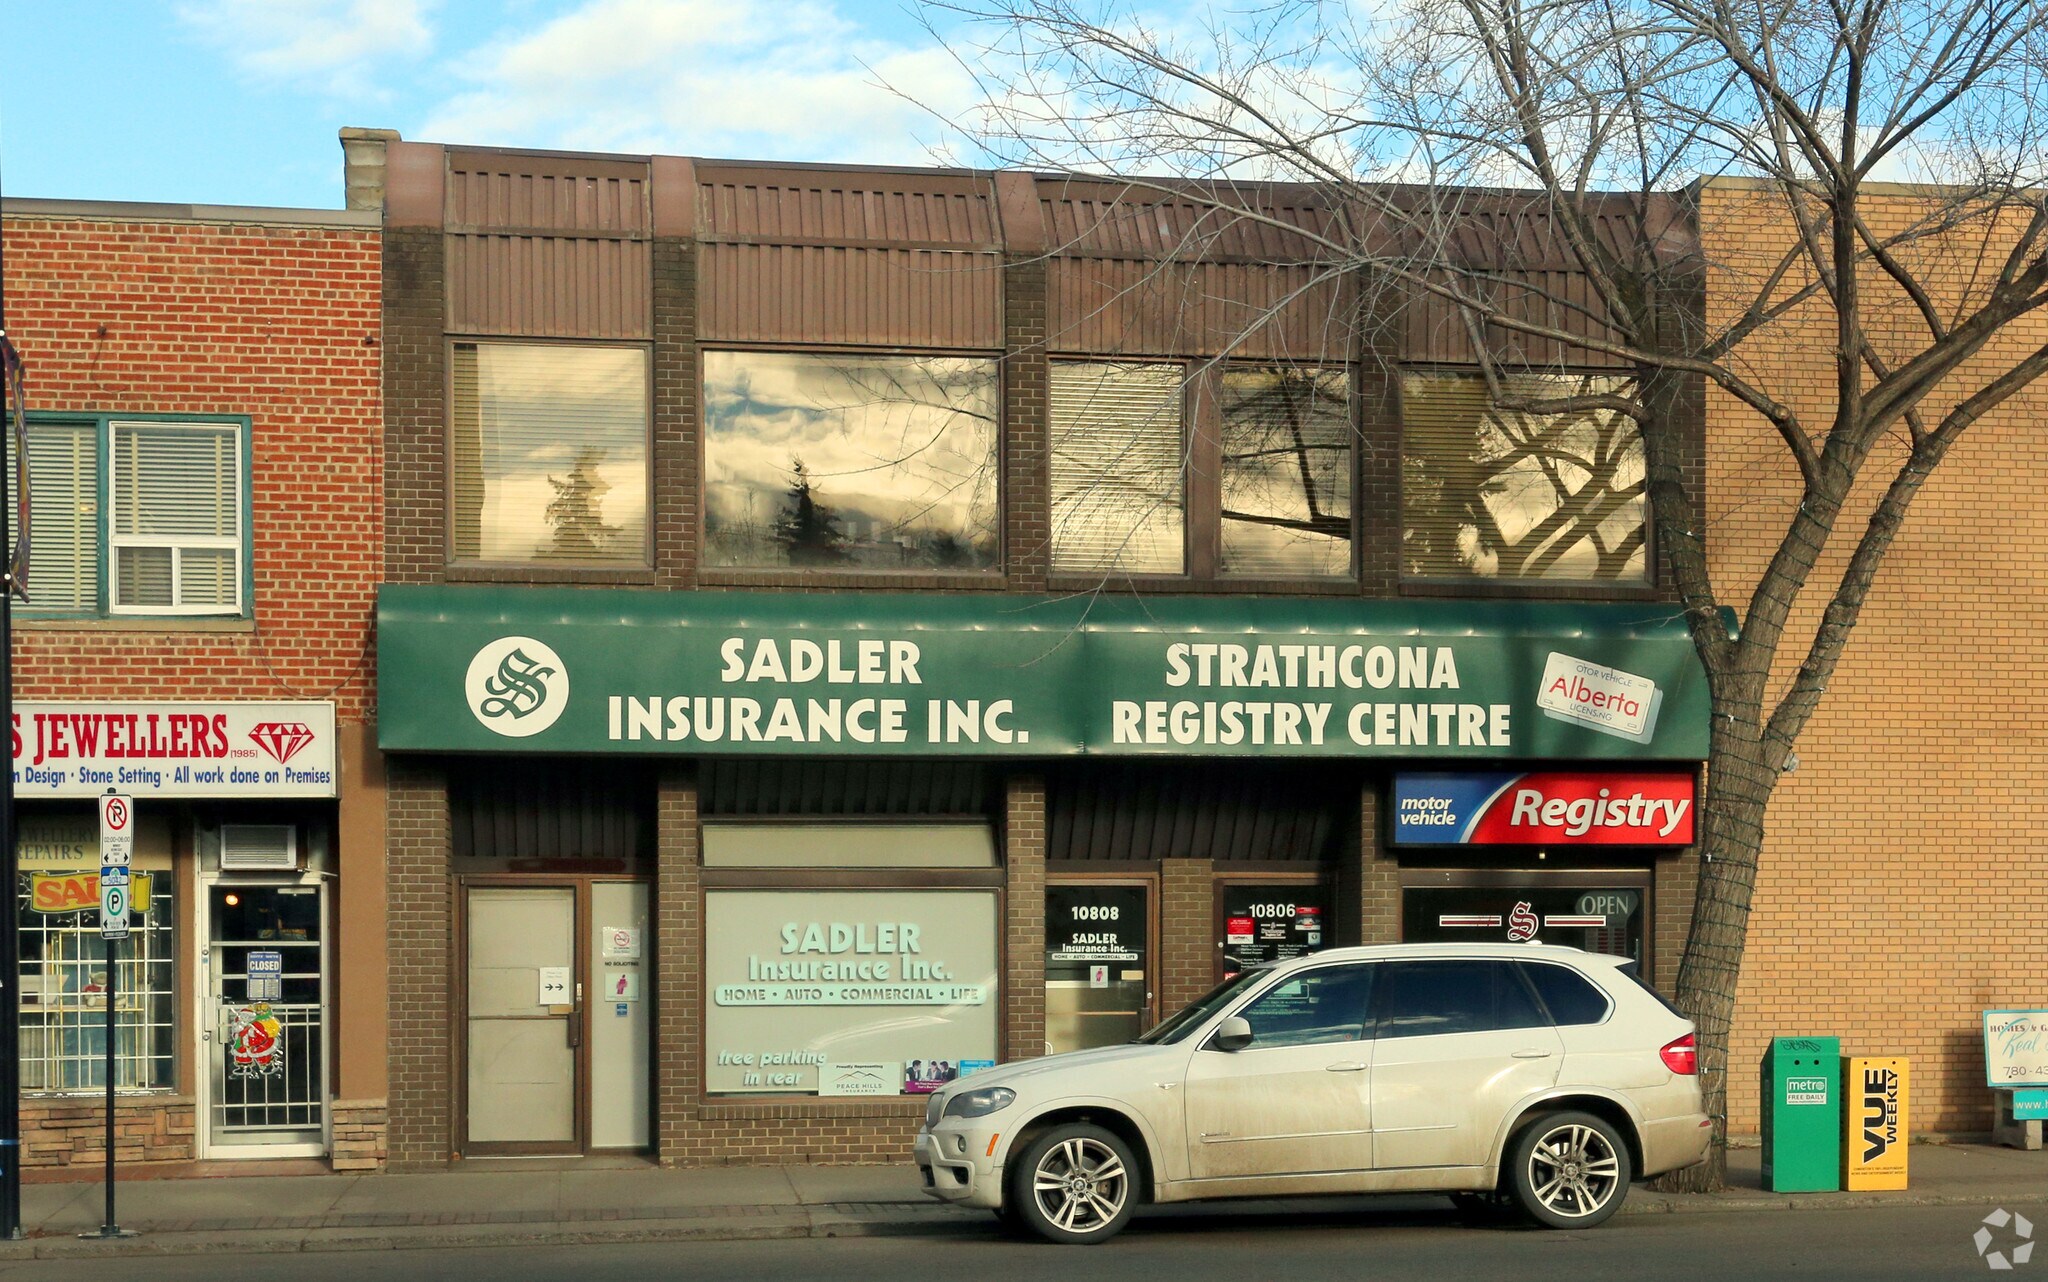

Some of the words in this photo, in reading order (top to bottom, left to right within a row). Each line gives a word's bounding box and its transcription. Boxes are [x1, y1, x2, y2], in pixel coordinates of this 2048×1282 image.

[720, 637, 923, 684] SADLER
[1165, 643, 1460, 690] STRATHCONA
[1548, 675, 1640, 717] Alberta
[607, 696, 908, 743] INSURANCE
[926, 698, 1030, 744] INC.
[1112, 701, 1332, 746] REGISTRY
[1347, 703, 1511, 747] CENTRE
[33, 713, 229, 766] JEWELLERS
[25, 766, 66, 788] Design
[79, 766, 114, 784] Stone
[119, 766, 161, 788] Setting
[174, 766, 190, 784] All
[194, 767, 224, 784] work
[230, 767, 260, 784] done
[264, 770, 280, 784] on
[285, 766, 331, 784] Premises
[1401, 796, 1453, 811] motor
[1510, 788, 1690, 837] Registry
[1400, 810, 1457, 826] vehicle
[36, 876, 132, 908] SAL
[1071, 906, 1119, 921] 10808
[1248, 903, 1296, 918] 10806
[1581, 896, 1629, 915] OPEN
[780, 921, 922, 955] SADLER
[1062, 943, 1107, 953] Insurance
[1110, 943, 1128, 953] Inc.
[1072, 933, 1117, 944] SADLER
[250, 960, 280, 971] CLOSED
[748, 954, 891, 982] Insurance
[901, 953, 954, 982] Inc.
[724, 988, 766, 1001] HOME
[784, 988, 823, 1001] AUTO
[840, 988, 933, 1000] COMMERCIAL
[950, 988, 979, 1000] LIFE
[718, 1050, 754, 1066] free
[759, 1048, 827, 1068] parking
[744, 1069, 761, 1086] in
[767, 1072, 803, 1087] rear
[1788, 1079, 1825, 1091] metro
[1806, 1093, 1825, 1101] DAILY
[1886, 1069, 1898, 1145] WEEKLY
[1863, 1068, 1887, 1164] VUE
